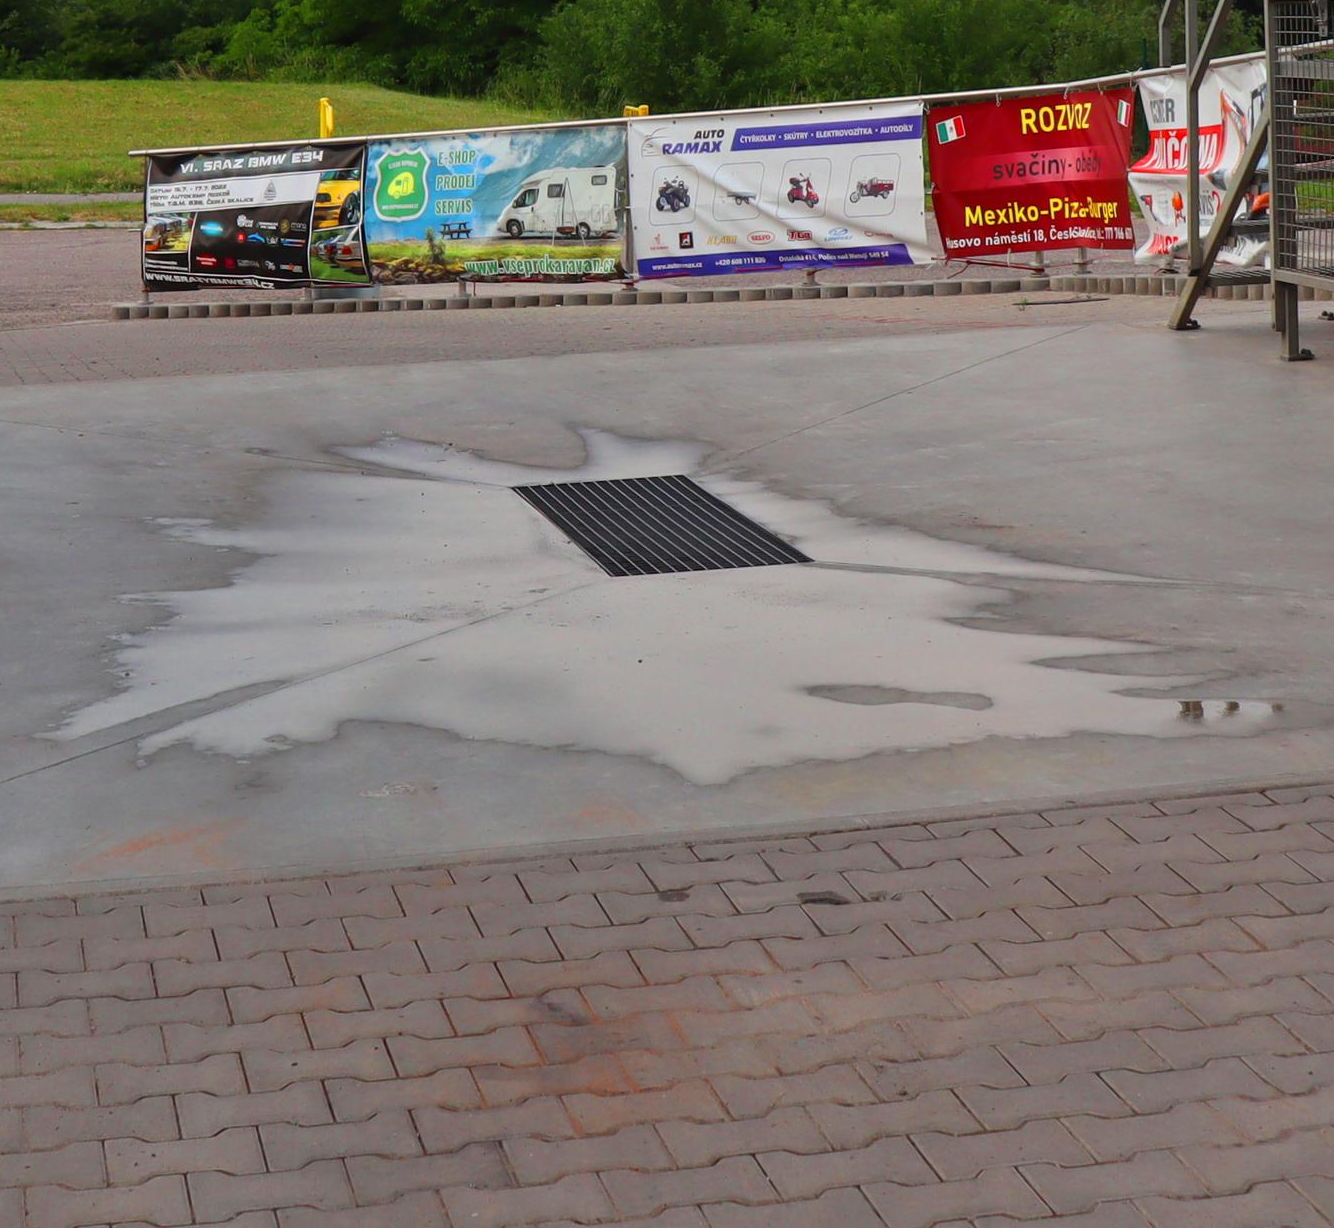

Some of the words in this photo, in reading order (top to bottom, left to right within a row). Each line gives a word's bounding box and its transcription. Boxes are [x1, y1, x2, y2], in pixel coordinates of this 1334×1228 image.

[1020, 103, 1092, 135] ROZVOZ
[693, 129, 725, 140] AUTO
[662, 140, 724, 155] RAMAX
[203, 158, 244, 172] SRAZ
[248, 153, 287, 169] BMW
[291, 150, 324, 163] E34
[437, 150, 476, 166] E-SHOP
[993, 152, 1066, 180] svačiny
[434, 198, 473, 215] SERVIS
[985, 229, 1031, 246] náměstí
[1034, 230, 1047, 243] 18,
[465, 254, 617, 277] www.vseprokaravan.cz
